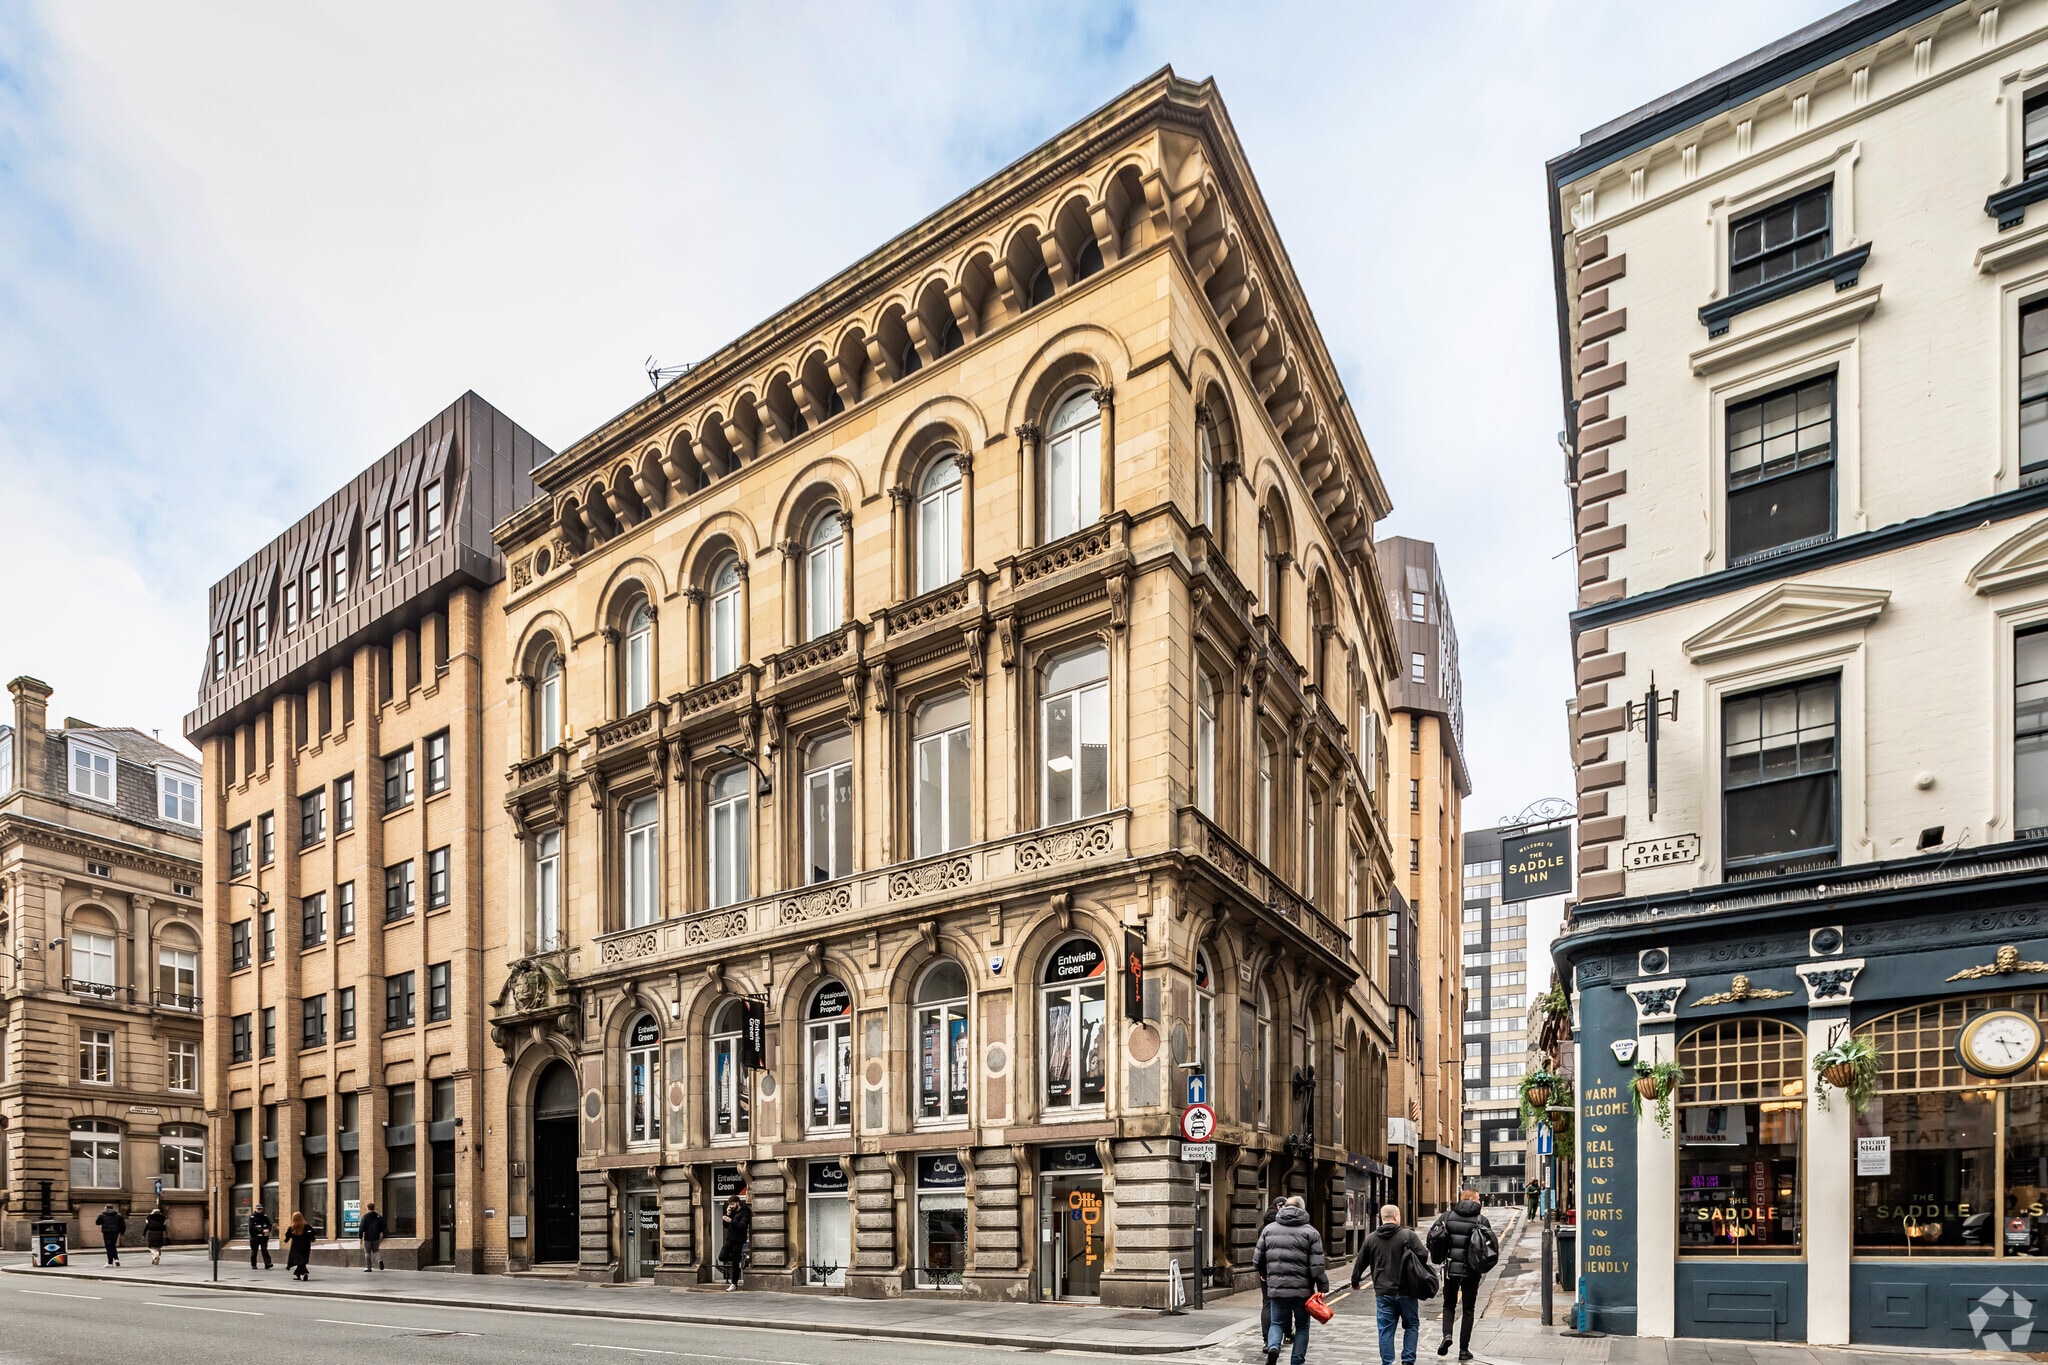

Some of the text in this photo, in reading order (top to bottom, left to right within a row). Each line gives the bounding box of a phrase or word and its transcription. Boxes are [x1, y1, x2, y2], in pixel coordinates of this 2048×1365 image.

[1519, 842, 1545, 853] WELCOME
[1638, 840, 1685, 854] DALE
[1634, 849, 1690, 865] STREET
[1509, 855, 1564, 874] SADDLE
[1524, 871, 1548, 884] INN
[1058, 951, 1097, 965] Entwistle
[1058, 965, 1084, 976] Green
[820, 999, 836, 1007] About
[820, 1005, 843, 1014] Property
[637, 1025, 659, 1034] Entwistl
[637, 1034, 654, 1042] Green
[1585, 1087, 1617, 1101] WARM
[1184, 1145, 1203, 1153] Except
[1586, 1139, 1615, 1153] REAL
[1860, 1144, 1886, 1152] NIGHT
[1586, 1156, 1614, 1169] ALES
[717, 1174, 742, 1182] Entwistle
[717, 1182, 735, 1190] Green
[1069, 1190, 1102, 1209] Ollie
[1587, 1192, 1613, 1204] LIVE
[1912, 1193, 1935, 1201] THE
[1584, 1209, 1623, 1220] PORTS
[1697, 1207, 1779, 1220] SADDLE
[1877, 1203, 1971, 1219] SADDLE
[1721, 1223, 1756, 1237] INN
[1589, 1245, 1611, 1257] DOG
[1584, 1262, 1629, 1273] IENDLY
